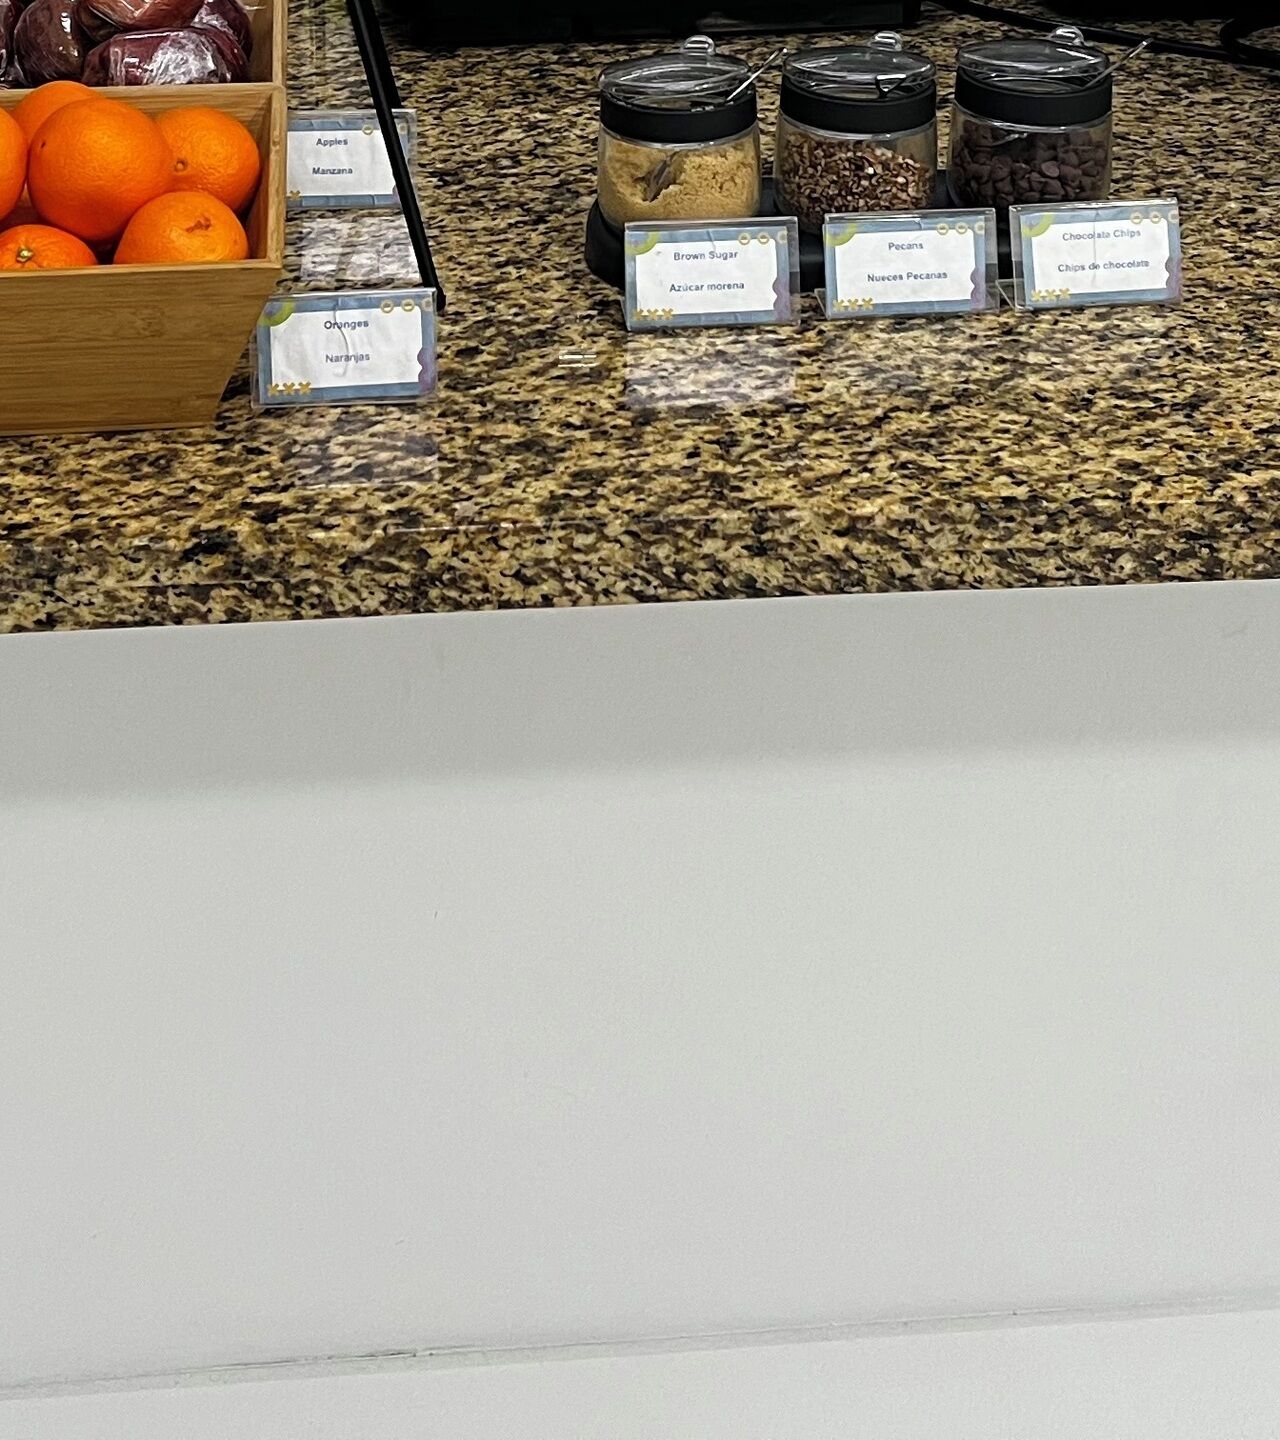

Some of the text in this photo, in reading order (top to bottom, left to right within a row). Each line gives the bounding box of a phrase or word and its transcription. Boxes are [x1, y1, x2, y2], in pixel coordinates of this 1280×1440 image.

[316, 137, 349, 147] Apples
[312, 167, 353, 175] Manzana
[1062, 228, 1142, 242] Chocolate Chips
[888, 241, 924, 251] Pecans
[673, 250, 738, 262] Brown Sugar
[1057, 259, 1150, 274] Chips de chocolate
[867, 271, 948, 283] Nueces Pecanas
[669, 281, 745, 293] Azúcar morena
[324, 320, 370, 330] Oranges
[325, 352, 370, 364] Naranjas
